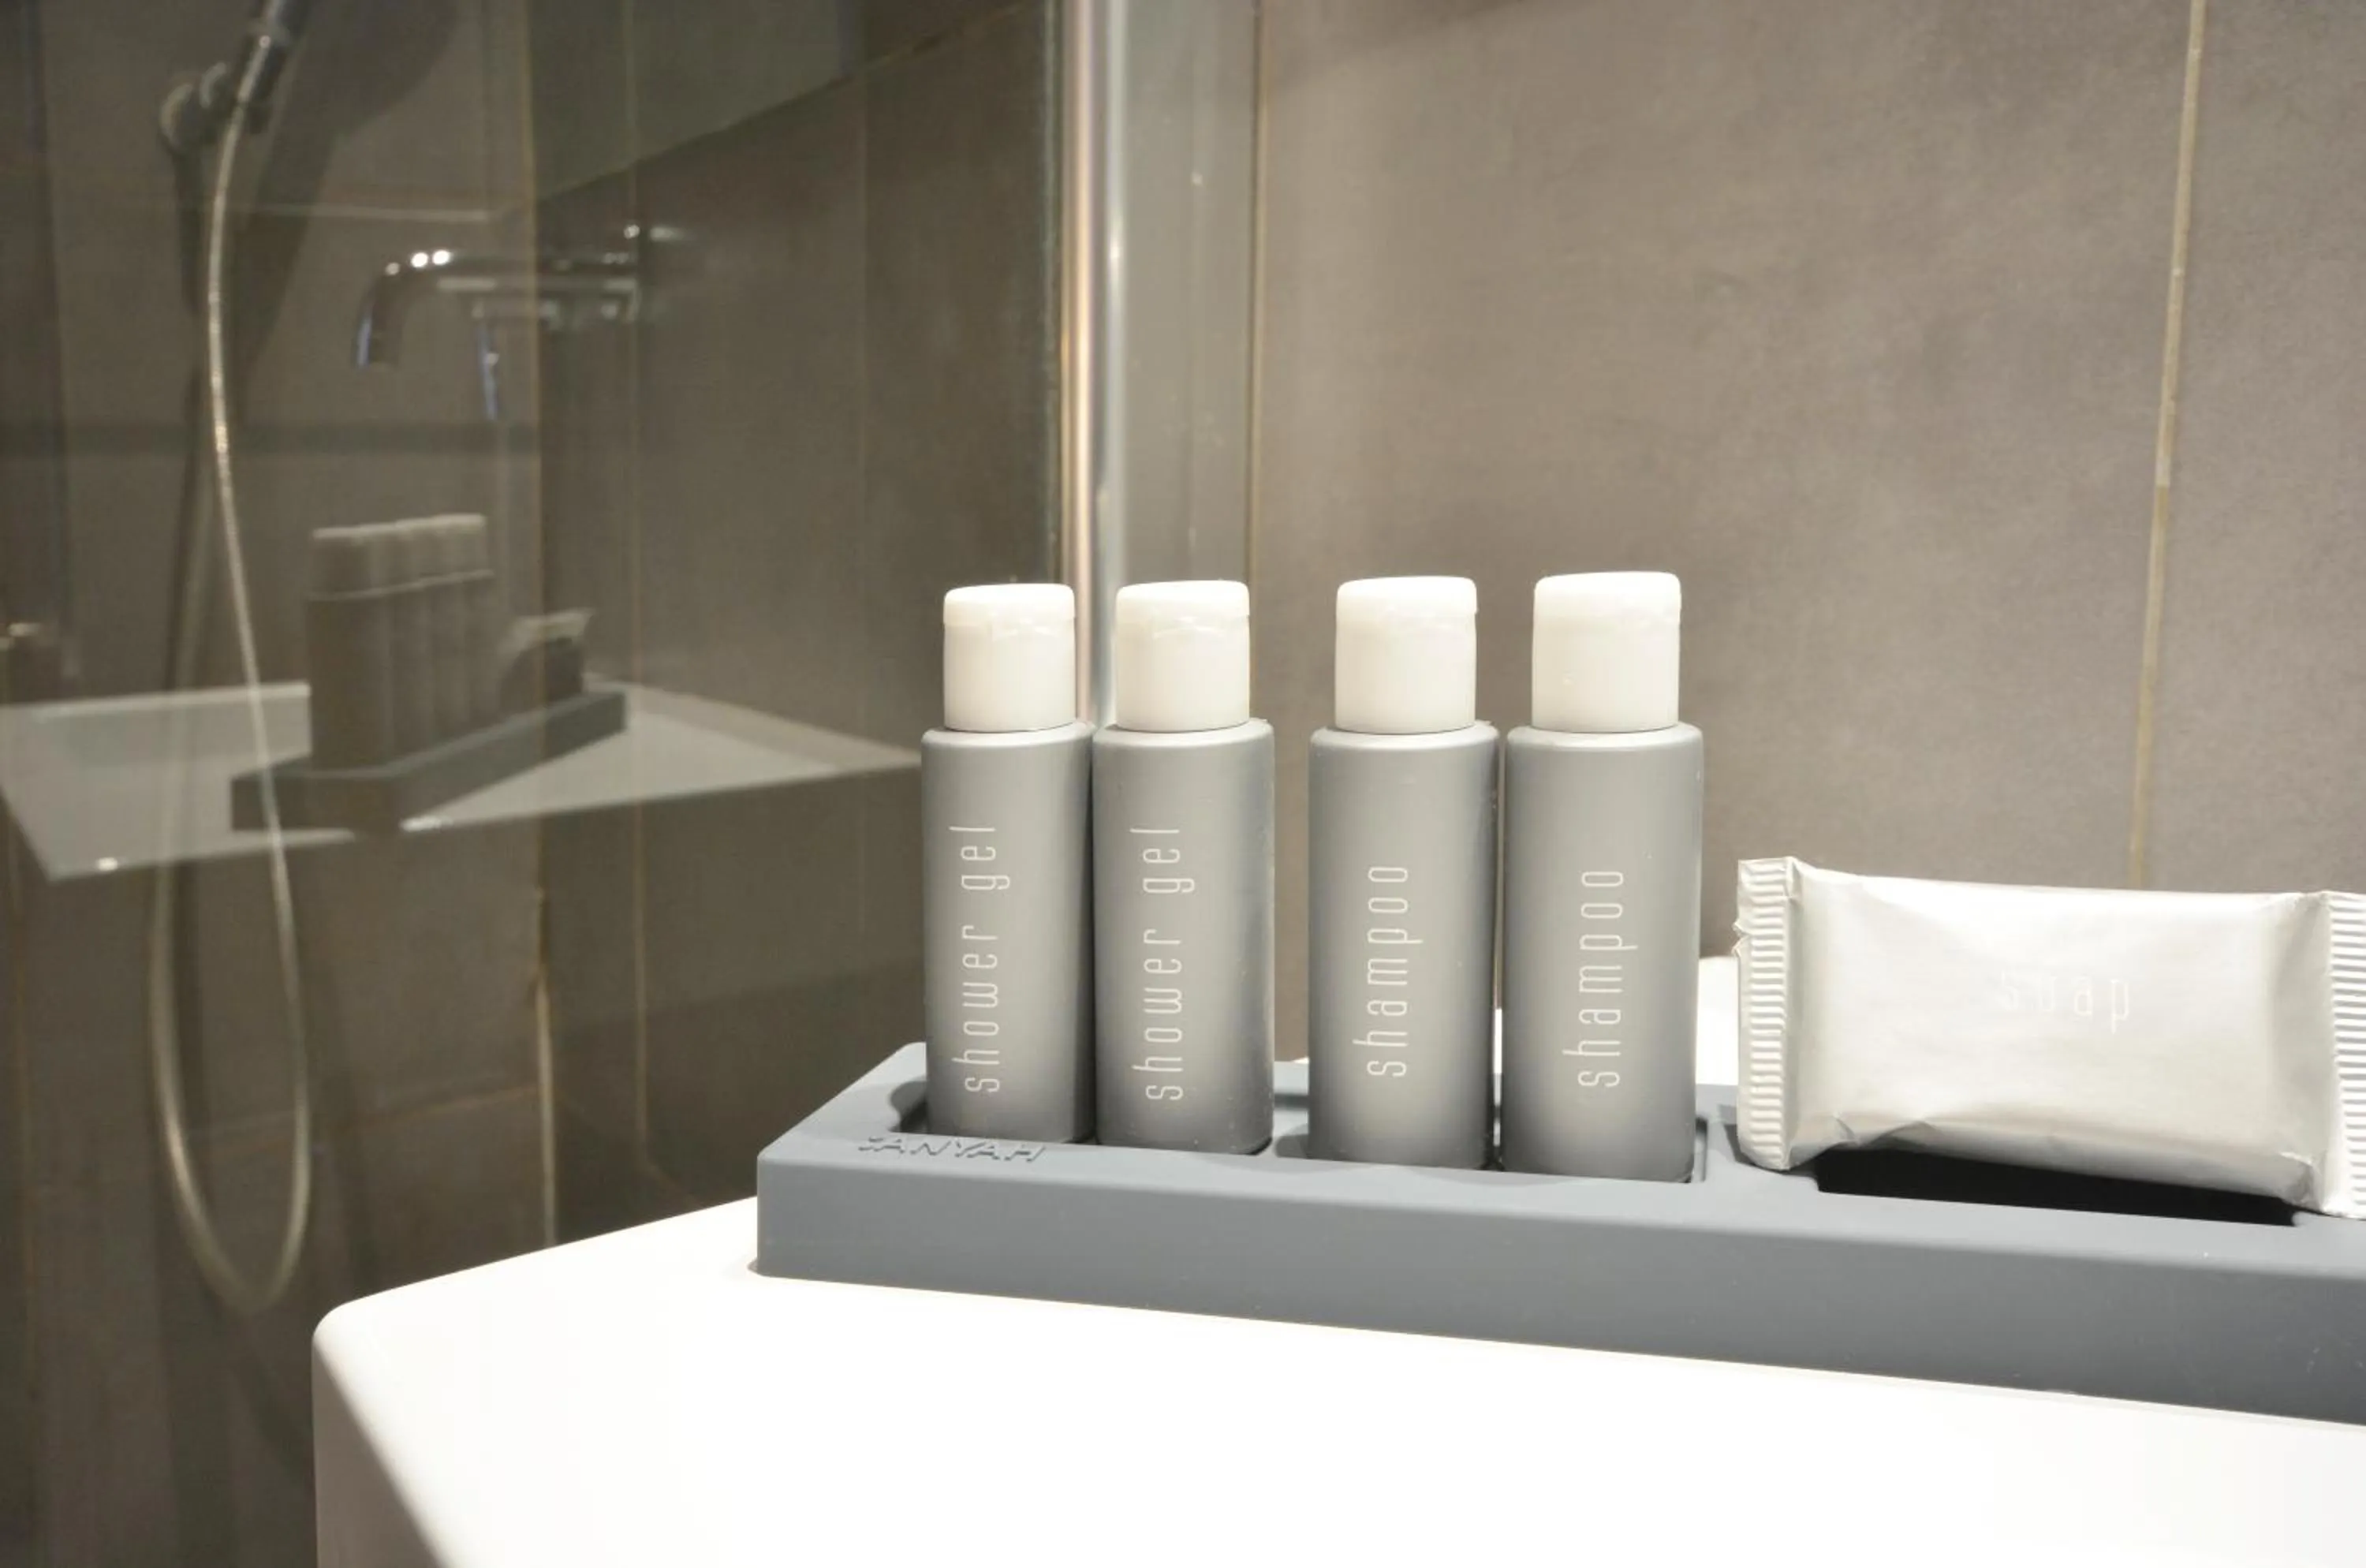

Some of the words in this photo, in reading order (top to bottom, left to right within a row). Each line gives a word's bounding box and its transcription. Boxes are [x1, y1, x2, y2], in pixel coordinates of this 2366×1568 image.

[948, 826, 1010, 890] gel
[1129, 828, 1195, 894] gel
[951, 924, 1001, 1093] shower
[1131, 928, 1183, 1101] shower
[1352, 866, 1424, 1077] shampoo
[1562, 871, 1638, 1088] shampoo
